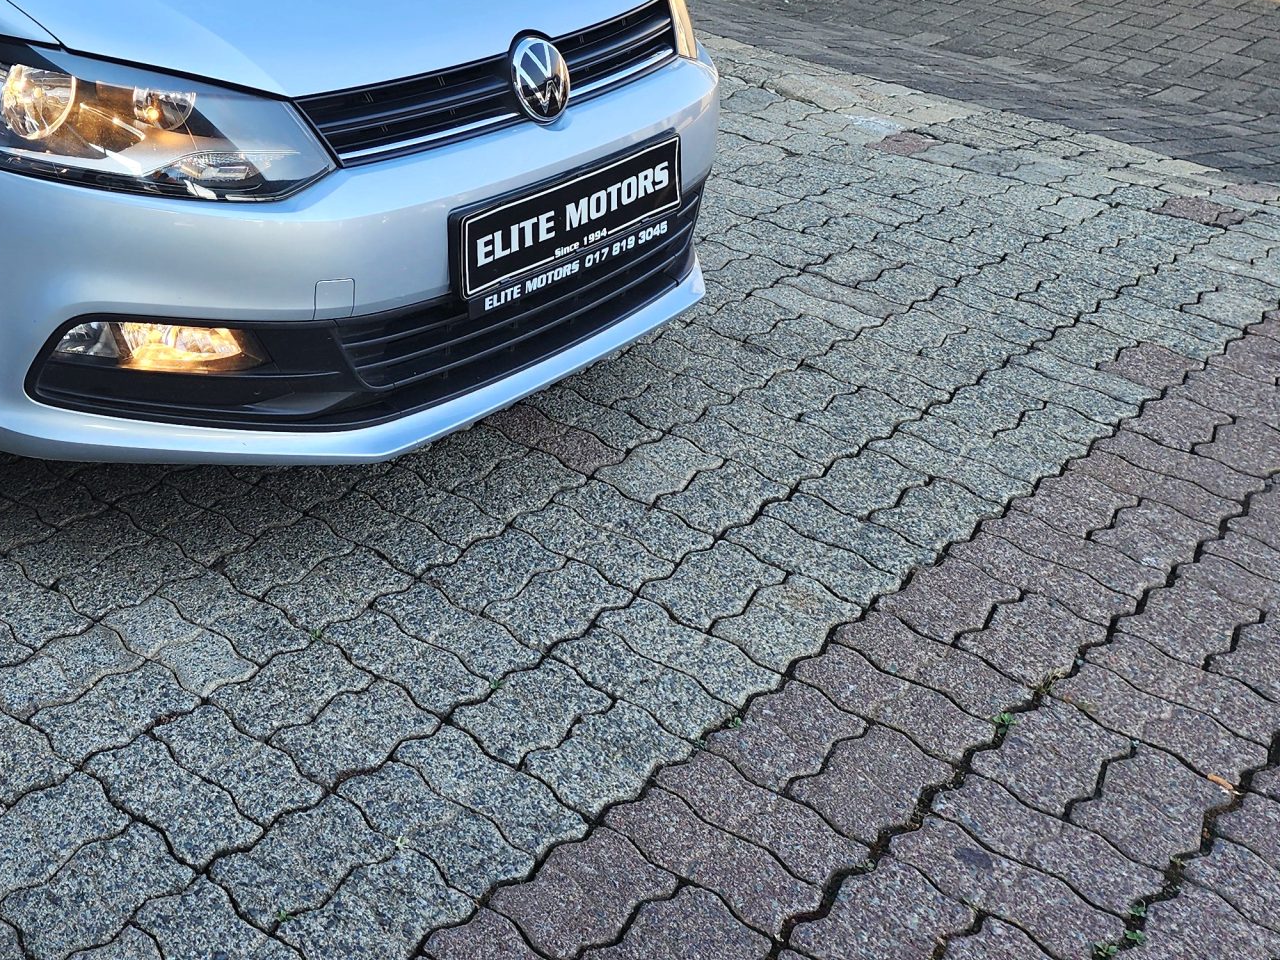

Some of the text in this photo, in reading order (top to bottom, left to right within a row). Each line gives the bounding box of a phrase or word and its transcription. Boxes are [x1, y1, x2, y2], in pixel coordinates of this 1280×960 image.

[476, 161, 669, 267] ELITE MOTORS
[554, 228, 608, 258] Since 1994
[484, 221, 668, 311] ELITE MOTORS 017 819 3045
